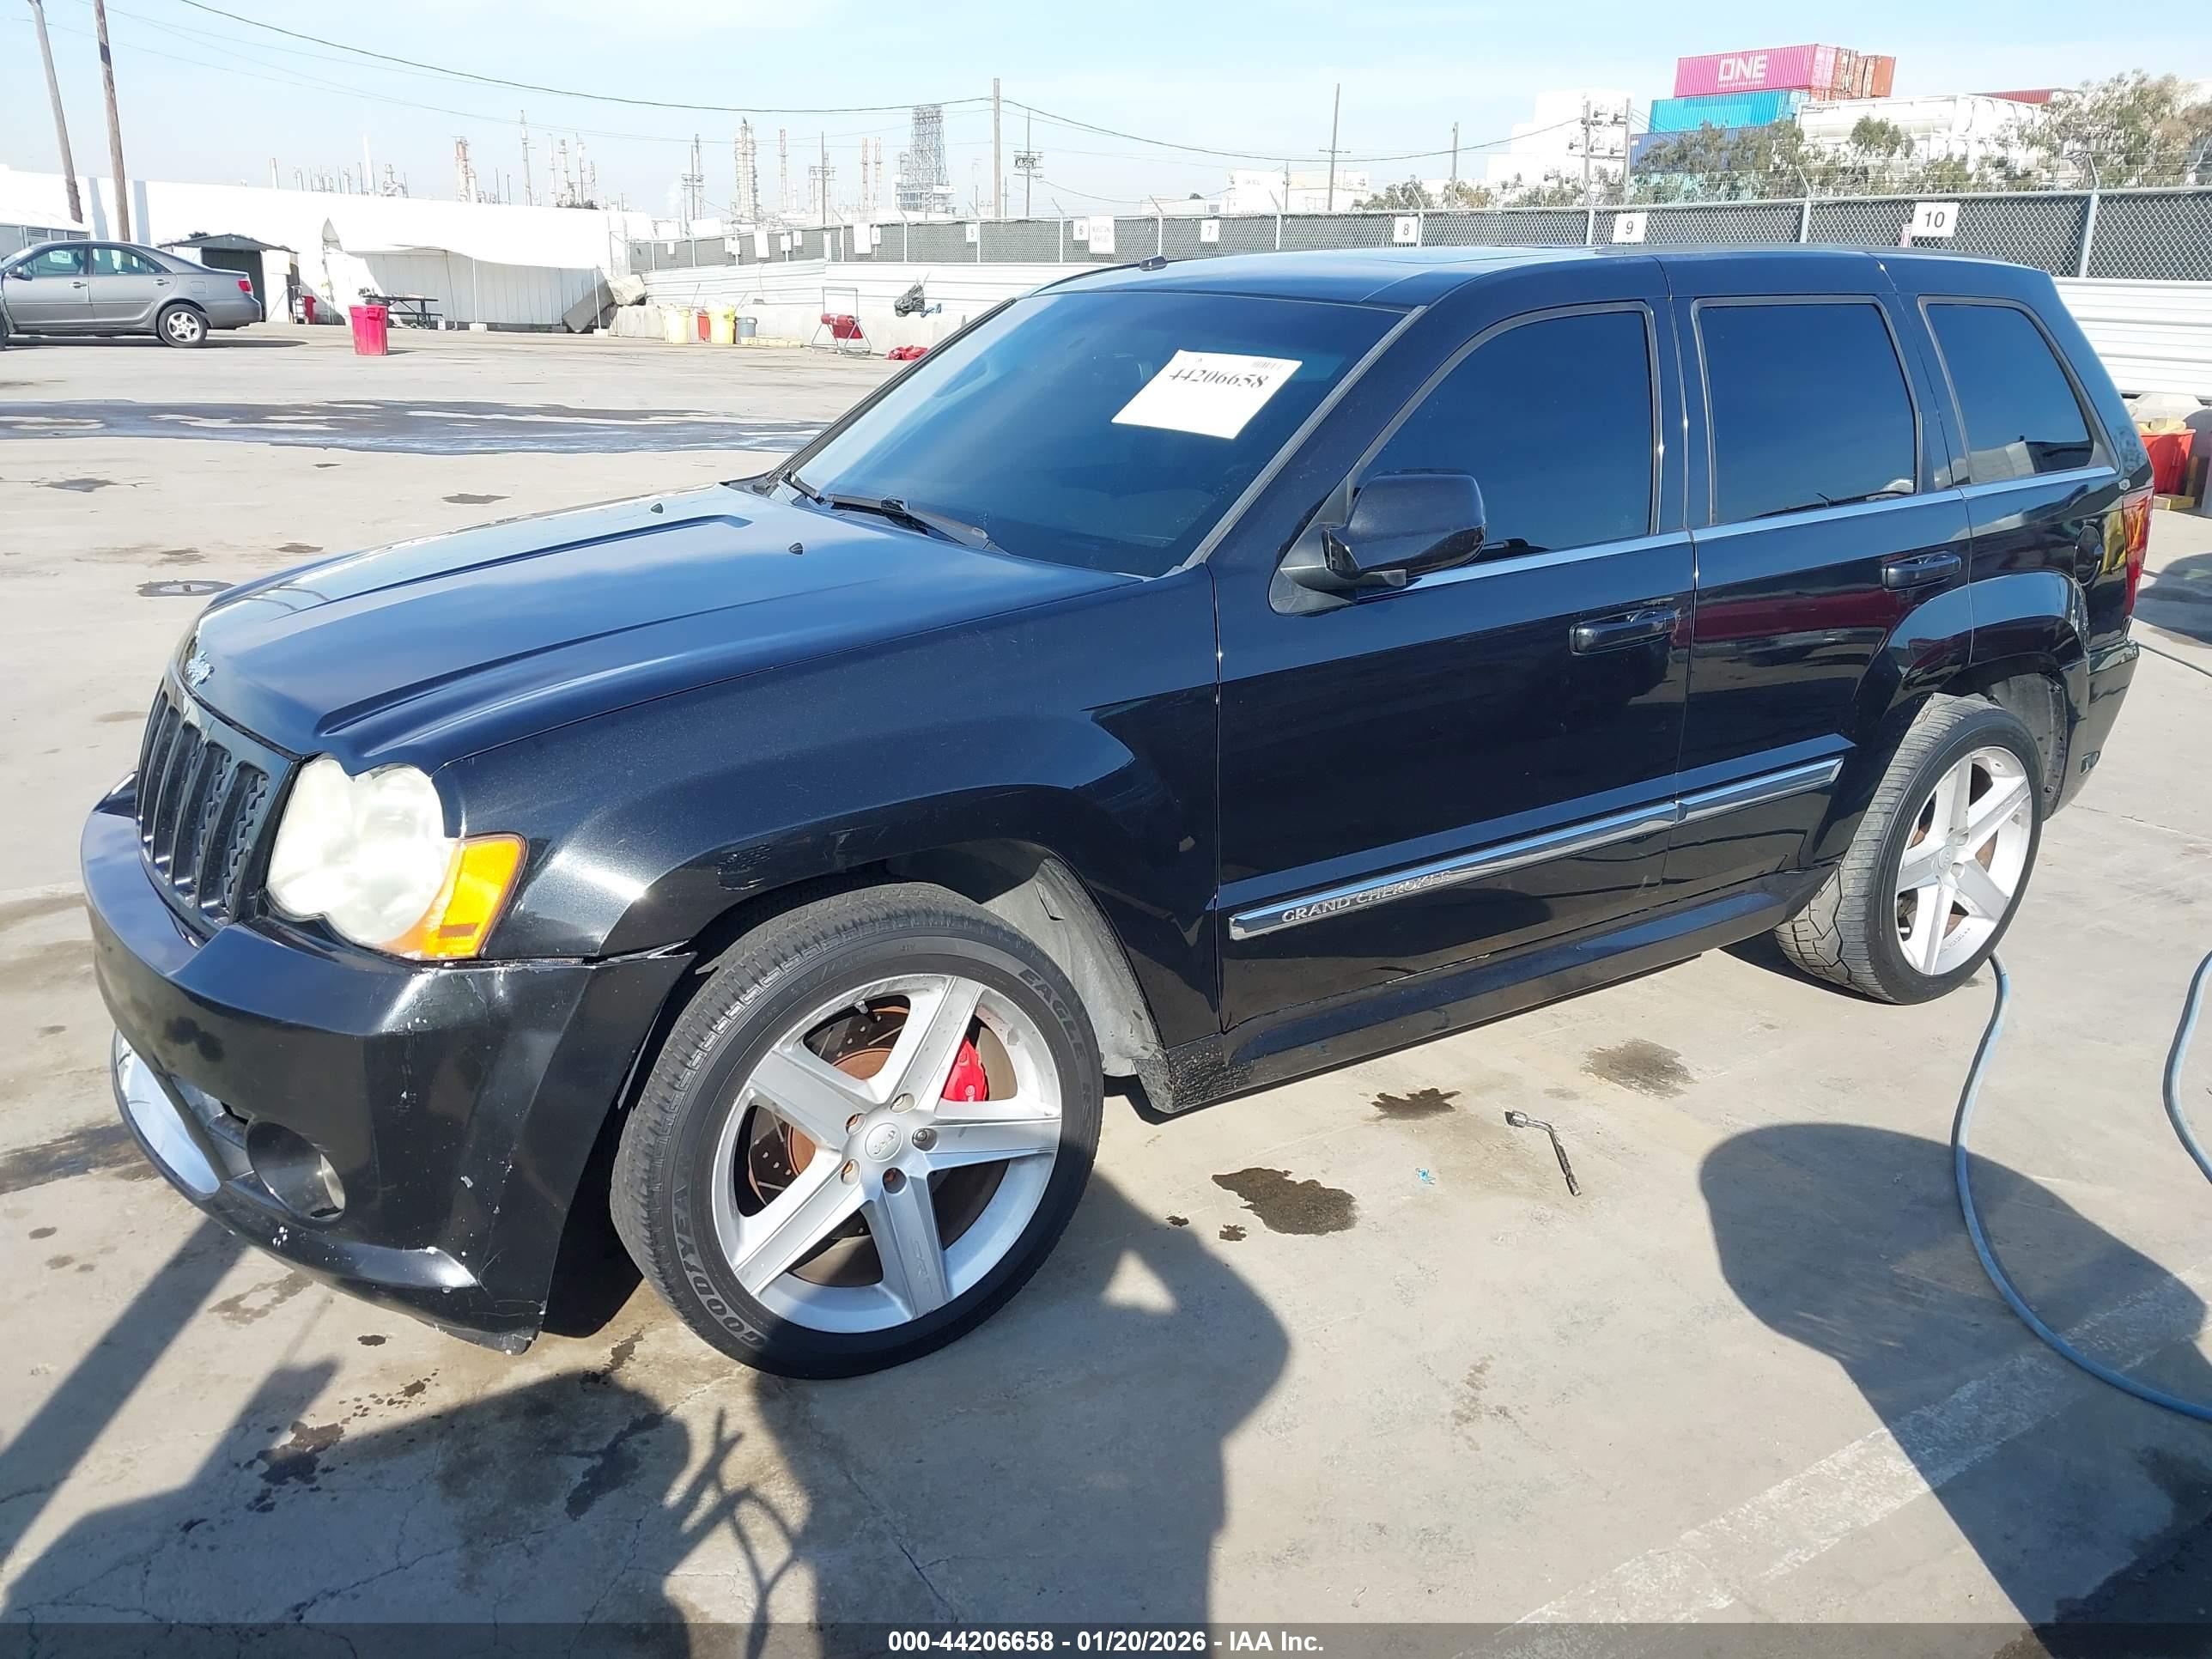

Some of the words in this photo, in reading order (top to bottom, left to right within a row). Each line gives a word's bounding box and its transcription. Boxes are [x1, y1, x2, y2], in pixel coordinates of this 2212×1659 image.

[1717, 55, 1768, 82] ONE
[1626, 221, 1634, 235] 9
[1924, 210, 1945, 228] 10
[1079, 225, 1084, 235] 6
[1207, 225, 1212, 236] 7
[1403, 223, 1410, 236] 8
[1169, 368, 1269, 388] 44206658
[1281, 897, 1351, 923] GRAND
[1355, 870, 1450, 903] CHEROKEE
[1018, 969, 1087, 1060] EAGLE
